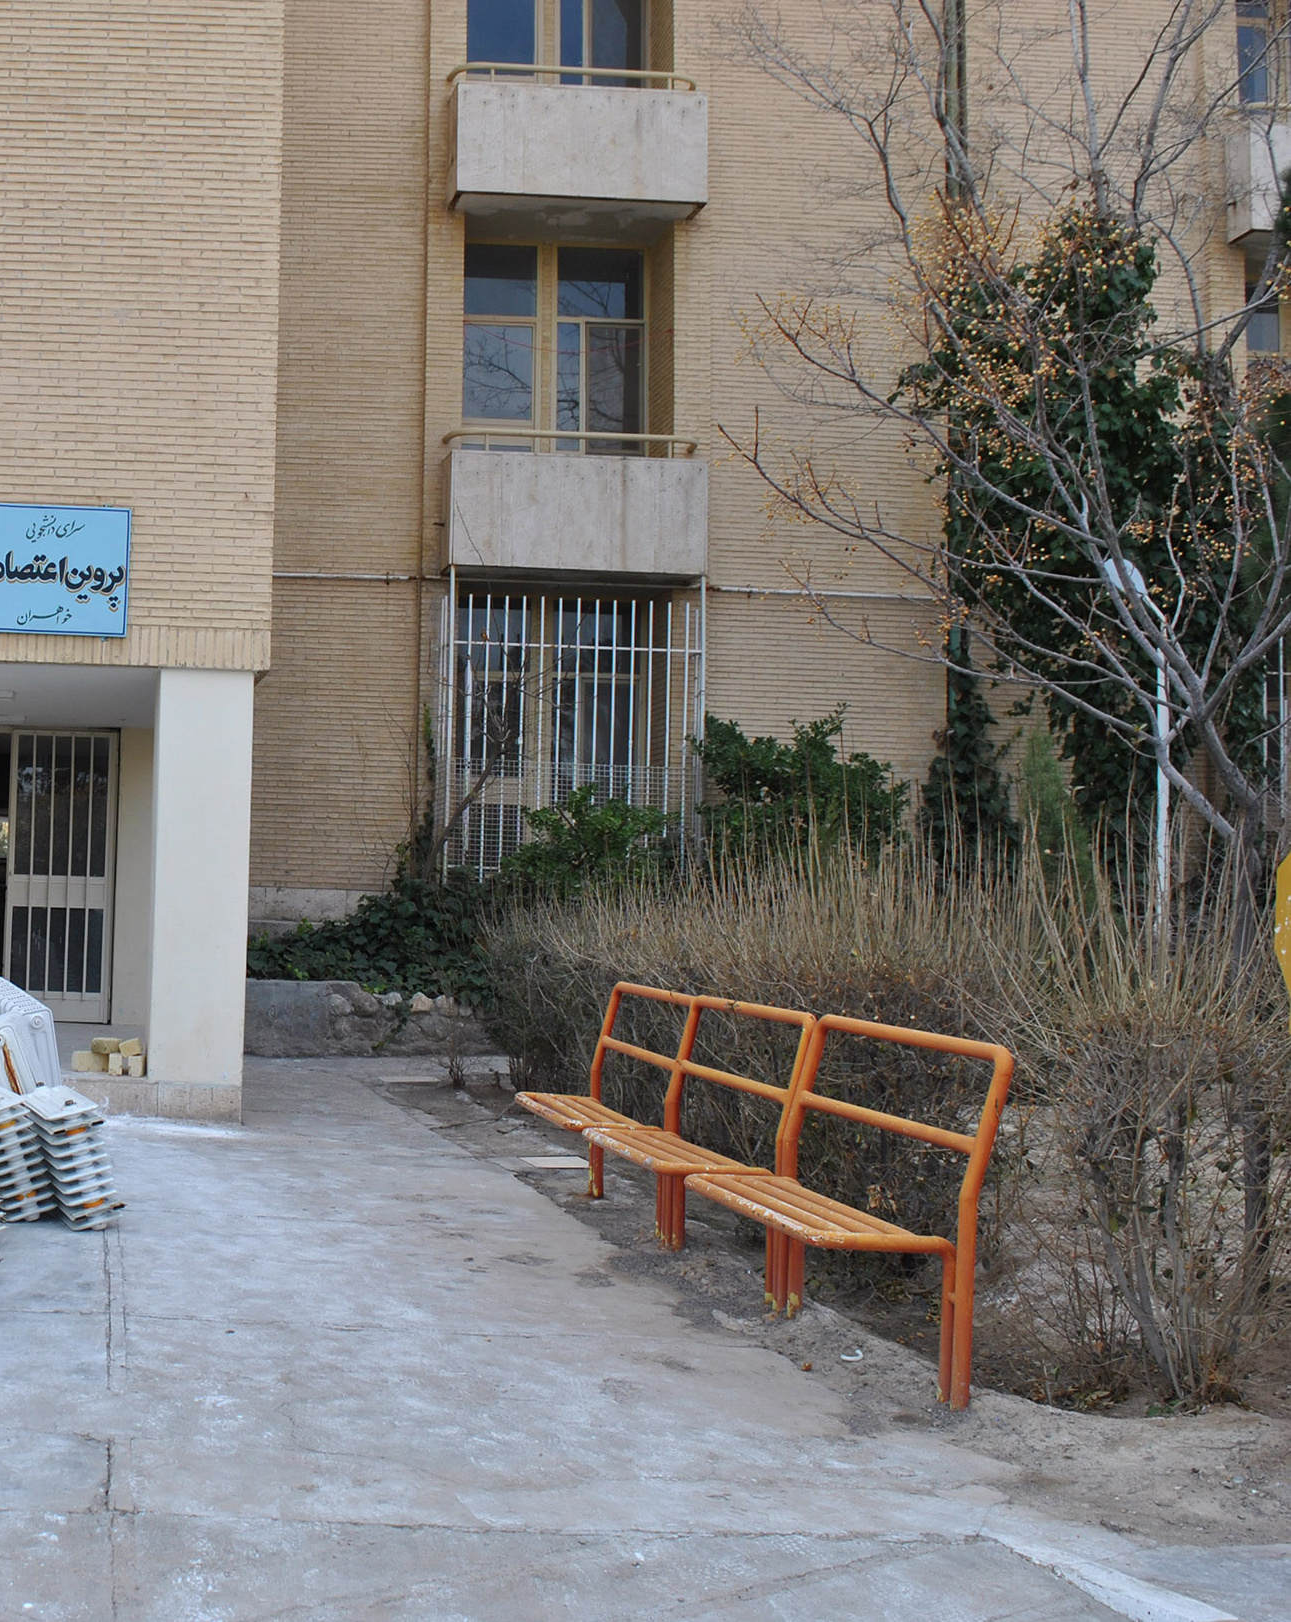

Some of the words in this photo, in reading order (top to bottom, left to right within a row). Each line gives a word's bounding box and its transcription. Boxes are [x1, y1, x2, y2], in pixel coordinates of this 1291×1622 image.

[55, 520, 86, 539] سرای
[64, 563, 127, 612] پروین
[16, 605, 73, 626] خواهران
